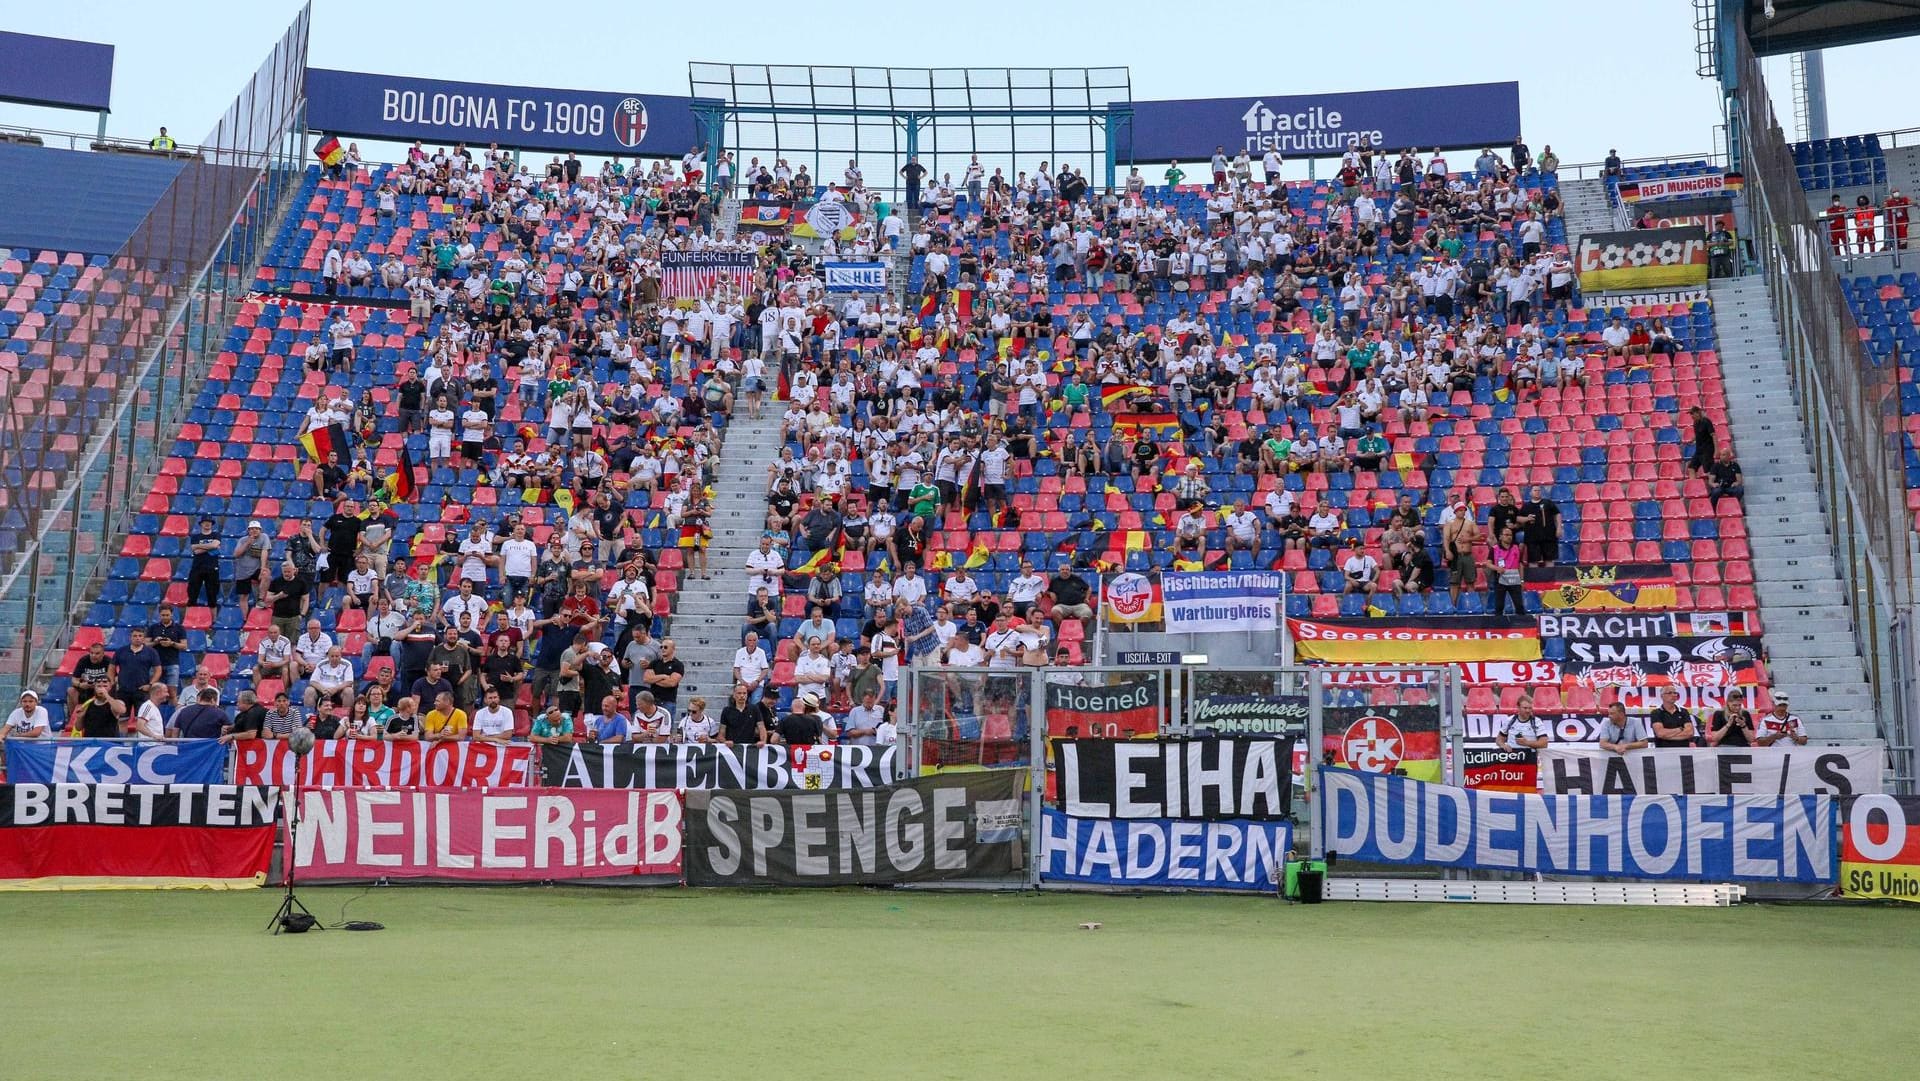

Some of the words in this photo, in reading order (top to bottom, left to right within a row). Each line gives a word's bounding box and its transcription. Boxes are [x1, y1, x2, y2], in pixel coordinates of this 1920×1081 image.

[383, 89, 499, 130] BOLOGNA
[506, 99, 536, 132] FC
[542, 101, 605, 136] 1909
[623, 100, 640, 110] BFC
[1246, 130, 1383, 151] ristrutturare
[1642, 185, 1664, 197] RED
[661, 252, 748, 263] FÜNFERKETTE
[1584, 290, 1707, 308] NEUSTRELITZ
[1164, 574, 1279, 591] Fischbach/Rhön
[1172, 604, 1271, 621] Wartburgkreis
[1299, 623, 1524, 640] Seestermühe
[1540, 616, 1665, 638] BRACHT
[1125, 653, 1150, 663] USCITA
[1156, 652, 1171, 663] EXIT
[1570, 642, 1682, 662] SMD
[1511, 662, 1556, 683] 93
[1690, 664, 1715, 672] NFC
[1057, 687, 1148, 711] Hoeneß
[1193, 698, 1309, 719] Neumünste
[1215, 719, 1287, 733] ON-TOUR
[51, 745, 178, 784] KSC
[235, 740, 533, 787] ROHRDORF
[1814, 753, 1853, 795] S
[1062, 740, 1282, 818] LEIHA
[1483, 771, 1498, 781] on
[1500, 769, 1524, 781] Tour
[13, 783, 280, 825] BRETTEN
[706, 786, 968, 877] SPENGE
[1324, 771, 1831, 879] DUDENHOFEN
[1041, 814, 1287, 885] HADERN
[1850, 870, 1873, 893] SG
[1880, 872, 1920, 896] Unio
